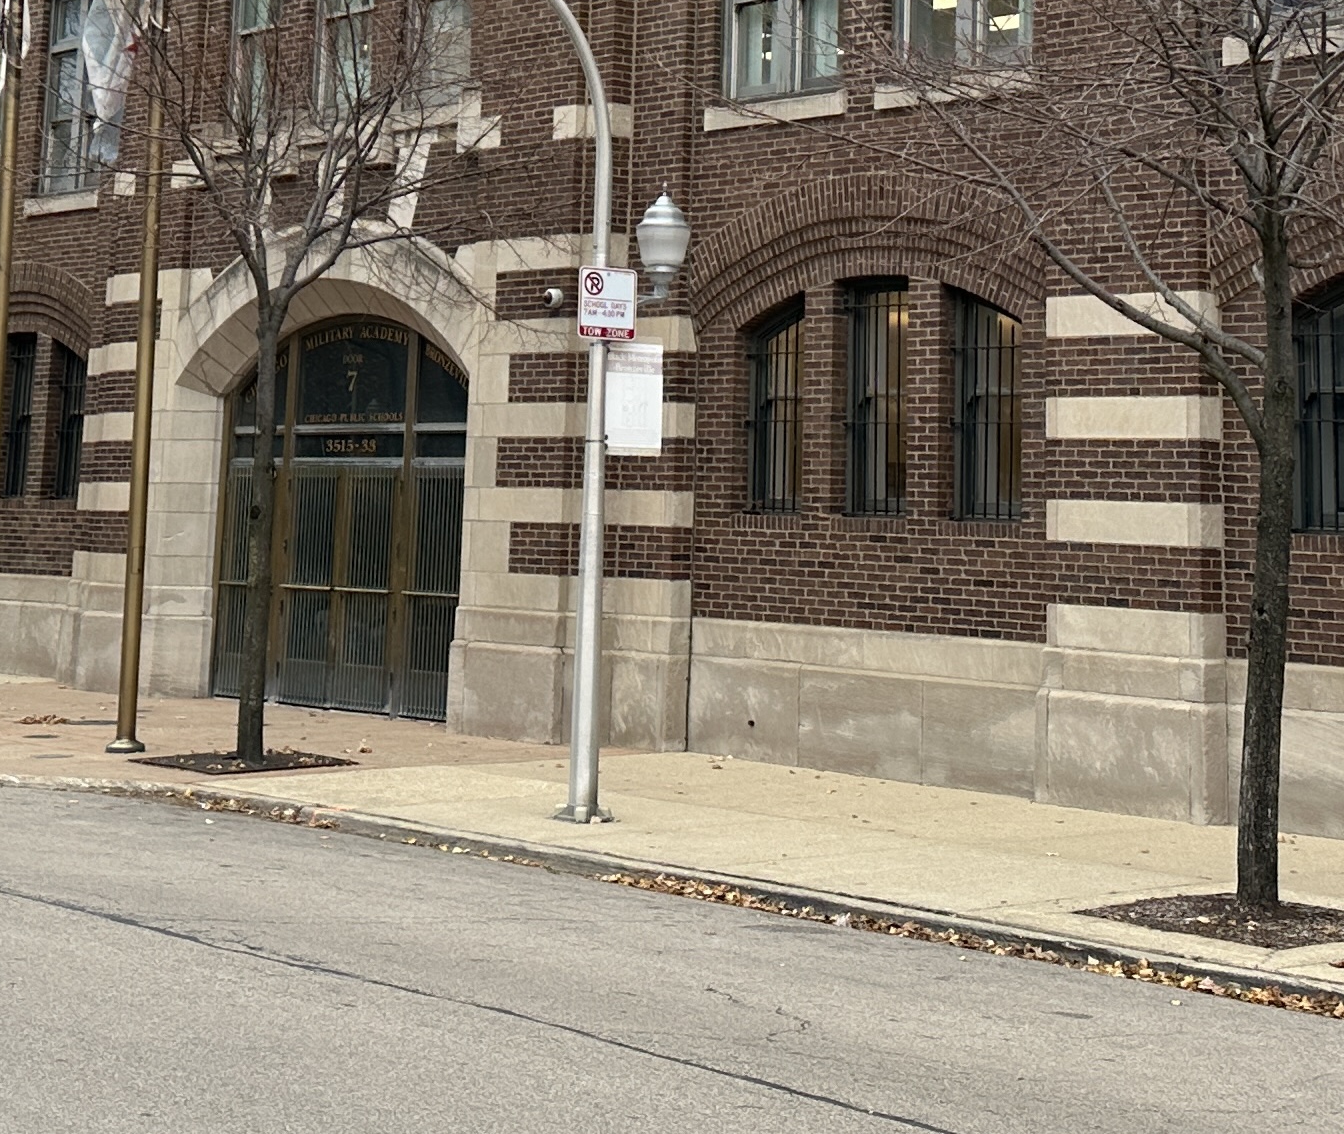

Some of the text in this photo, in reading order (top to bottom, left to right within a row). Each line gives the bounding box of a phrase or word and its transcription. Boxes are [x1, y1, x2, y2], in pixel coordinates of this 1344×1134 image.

[583, 299, 627, 311] SCHOOL DAYS
[305, 326, 354, 351] MILITARY
[360, 324, 410, 346] ACADEMY
[582, 326, 631, 339] TOW ZONE
[342, 353, 364, 365] DOOR
[346, 369, 358, 392] 7
[304, 411, 404, 424] CHICAGO PUBLIC SCHOOLS
